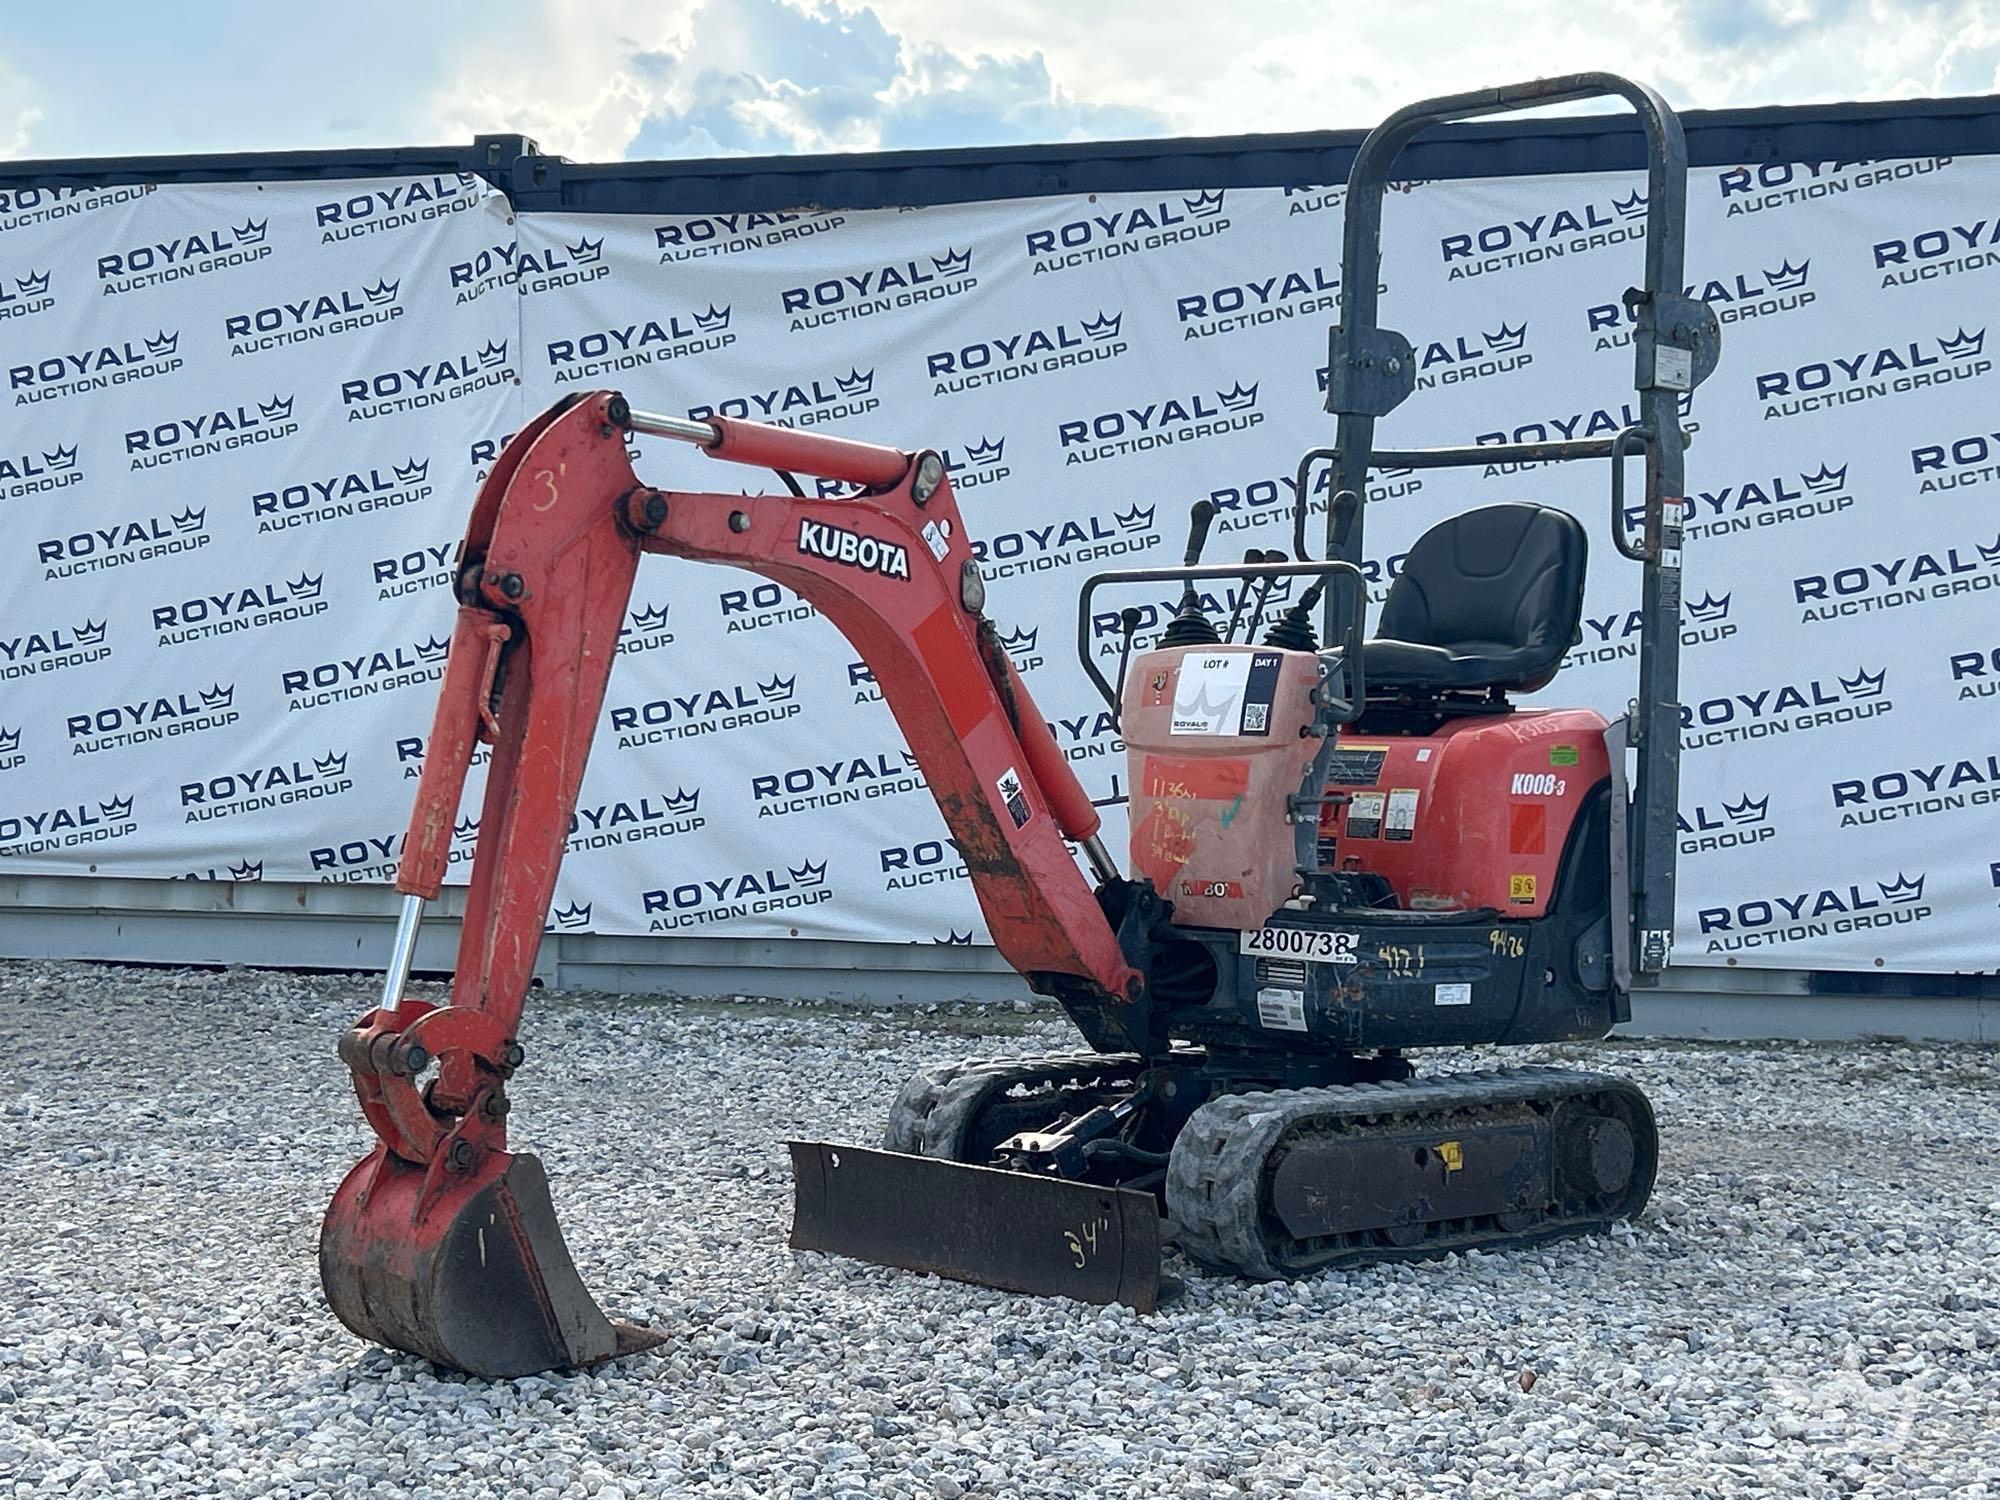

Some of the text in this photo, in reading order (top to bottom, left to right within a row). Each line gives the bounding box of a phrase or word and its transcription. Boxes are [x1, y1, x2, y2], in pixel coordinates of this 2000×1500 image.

[316, 177, 457, 227] ROYAL
[1727, 156, 1953, 217] AUCTION GROUP
[0, 202, 80, 231] UCTION
[322, 191, 487, 244] AUCTION GROU
[1026, 203, 1184, 256] ROYAL
[1441, 205, 1613, 262] ROYAL
[98, 231, 232, 278] ROYAL
[659, 216, 846, 266] AUCTION GROUP
[1033, 219, 1230, 275] AUCTION GROUP
[1449, 225, 1646, 281] AUCTION GROU
[1873, 219, 2000, 270] ROY
[103, 246, 272, 296] AUCTION GROUP
[450, 241, 568, 288] ROYAL
[533, 265, 610, 293] GROUP
[0, 297, 55, 321] ROUP
[781, 262, 934, 314] ROYAL
[790, 278, 977, 332] AUCTION GROUP
[1177, 268, 1340, 323] ROYAL
[1720, 291, 1817, 324] GROUP
[226, 291, 364, 340] ROYAL
[231, 307, 403, 357] AUCTION GROUP
[1185, 305, 1293, 341] AUCTION
[547, 317, 693, 365] ROYAL
[555, 334, 736, 384] AUCTION GROUP
[927, 326, 1082, 378] ROYAL
[9, 343, 145, 389] ROYAL
[15, 359, 183, 406] AUCTION GROUP
[342, 356, 478, 404] ROYAL
[934, 343, 1127, 396] AUCTION GROUP
[1442, 354, 1532, 385] GROUP
[1756, 343, 1938, 400] ROYAL
[349, 369, 515, 422] AUCTION GROUP
[800, 398, 880, 426] GROUP
[1764, 361, 1991, 420] AUCTION GROUP
[125, 407, 259, 454] ROYAL
[1059, 396, 1217, 447] ROYAL
[1066, 413, 1264, 466] AUCTION GROUP
[131, 423, 298, 471] AUCTION GROUP
[10, 471, 84, 498] GROUP
[253, 470, 394, 516] ROYAL
[950, 466, 1010, 489] ROUP
[1365, 479, 1423, 503] OUP
[258, 486, 432, 534] AUCTION GROUP
[1757, 496, 1853, 526] GROUP
[38, 518, 172, 564] ROYAL
[45, 535, 210, 581] AUCTION GROUP
[373, 543, 452, 583] ROY
[800, 520, 909, 579] KUBOTA
[981, 535, 1160, 582] UCTION GROUP
[1795, 548, 1977, 604] ROYAL
[153, 585, 287, 630] ROYAL
[158, 602, 328, 647] AUCTION GROUP
[726, 605, 816, 634] AUCTIO
[1802, 588, 1925, 623] AUCTION
[0, 630, 73, 661] YAL
[41, 648, 111, 671] GROUP
[615, 633, 675, 656] ROUP
[1203, 659, 1222, 669] LOT
[1254, 658, 1278, 668] DAY 1
[1559, 643, 1637, 669] CTION
[1681, 624, 1738, 646] OUP
[282, 648, 415, 694] ROYAL
[289, 667, 446, 712] AUCTION GROU
[67, 694, 200, 738] ROYAL
[610, 686, 758, 731] ROYAL
[618, 705, 801, 749] AUCTION GROUP
[1680, 701, 1892, 751] UCTION GROUP
[73, 712, 239, 755] AUCTION GROUP
[180, 762, 313, 806] ROYAL
[752, 754, 901, 800] ROYAL
[1511, 773, 1566, 796] K008-3
[0, 805, 100, 841] OYAL
[185, 780, 353, 823] AUCTION GROUP
[759, 789, 860, 818] AUCTION
[1841, 794, 1965, 828] AUCTION
[0, 823, 138, 857] CTION GROUP
[310, 833, 408, 870] ROY
[626, 817, 706, 843] GROUP
[1681, 827, 1775, 854] GROUP
[642, 871, 790, 914] ROYAL
[886, 865, 970, 891] AUCTIO
[649, 890, 832, 932] AUCTION GROUP
[1699, 886, 1879, 934] ROYAL
[1706, 907, 1931, 954] AUCTION GROUP
[1248, 928, 1350, 955] 2800738
